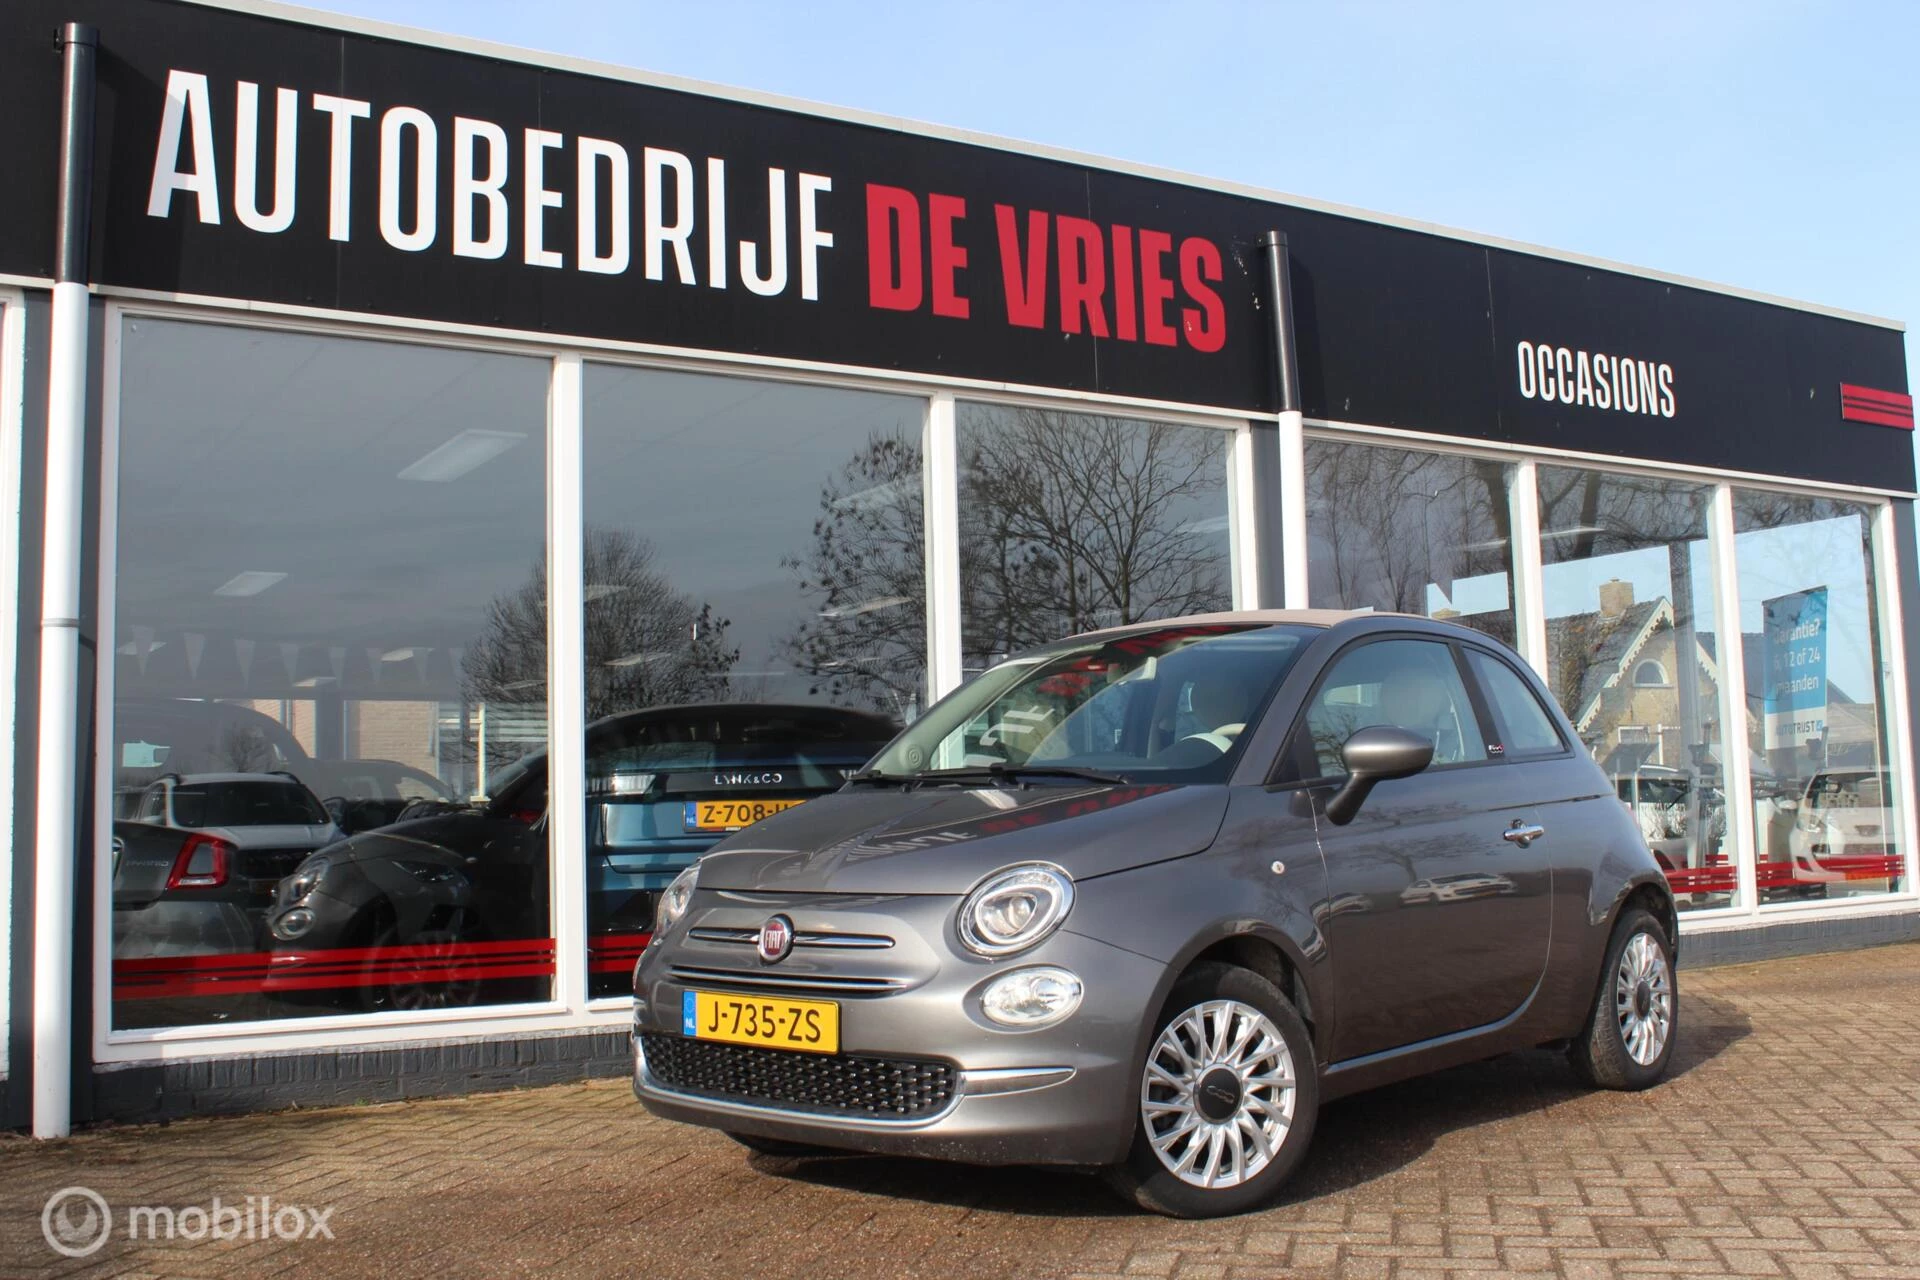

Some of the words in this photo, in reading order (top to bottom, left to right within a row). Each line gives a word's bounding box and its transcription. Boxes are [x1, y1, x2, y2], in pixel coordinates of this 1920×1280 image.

[147, 69, 835, 301] AUTOBEDRIJF
[865, 183, 970, 319] DE
[994, 193, 1226, 353] VRIES
[1517, 340, 1676, 419] OCCASIONS
[1808, 646, 1821, 664] 24
[764, 930, 784, 949] FIAT
[708, 1001, 821, 1043] J-735-ZS
